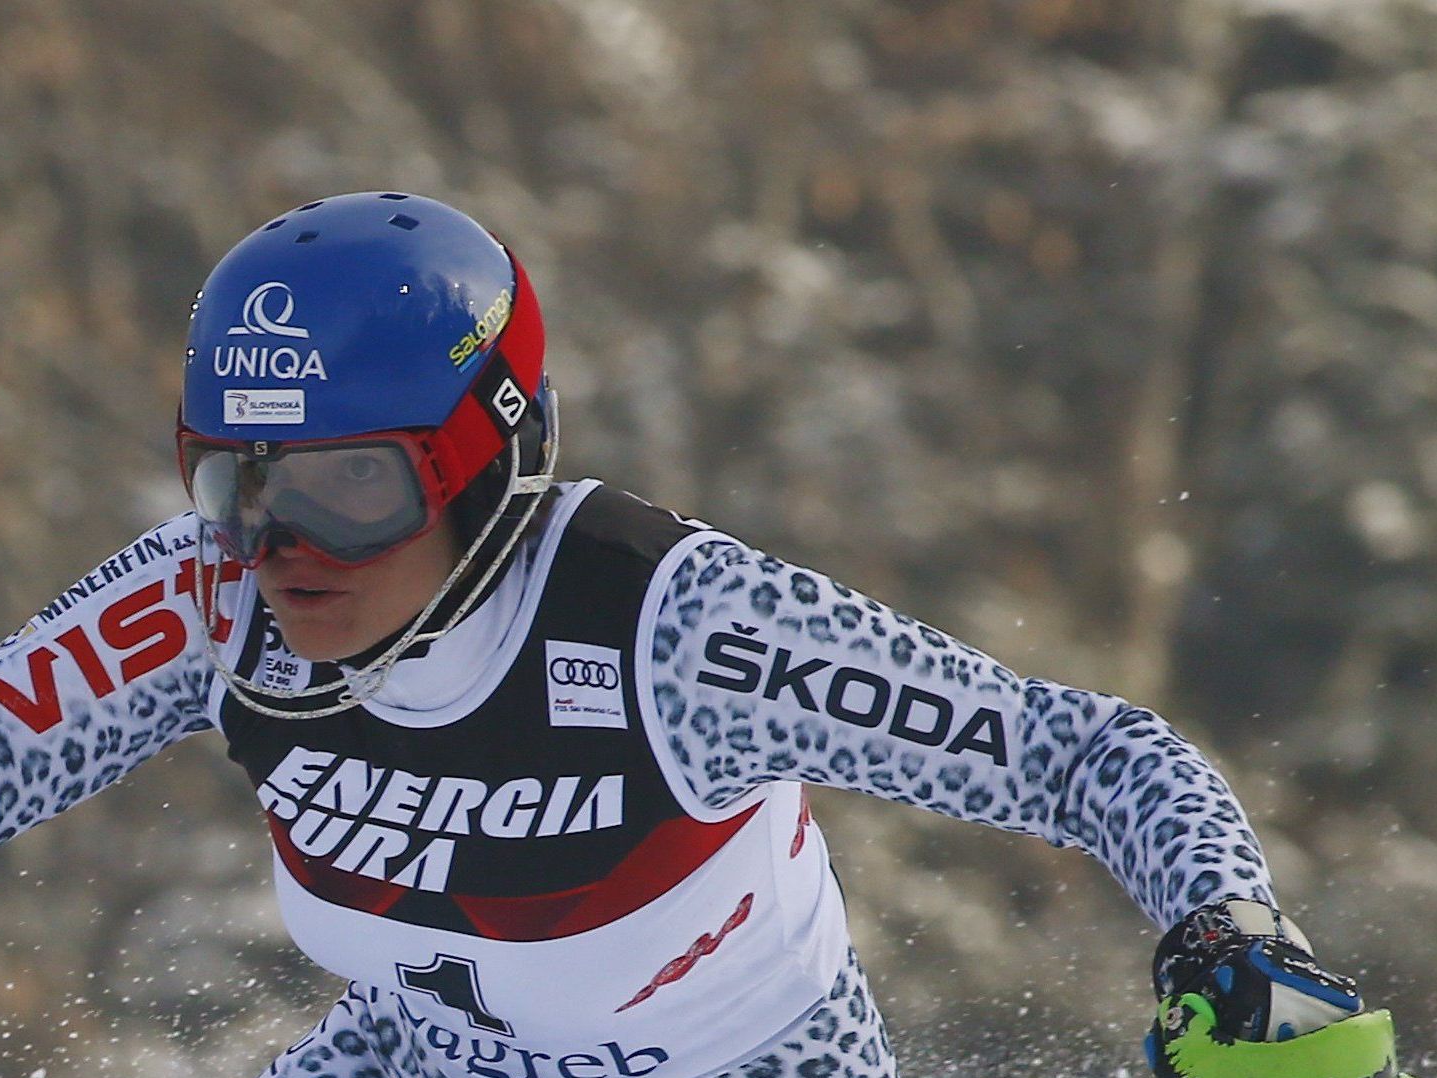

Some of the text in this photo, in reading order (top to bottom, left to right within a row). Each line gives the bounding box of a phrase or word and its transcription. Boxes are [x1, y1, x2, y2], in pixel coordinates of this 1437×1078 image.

[214, 346, 328, 381] UNIQA
[266, 657, 300, 677] EARS
[696, 621, 1008, 768] ŠKODA
[266, 745, 624, 839] ENERGIA
[395, 952, 516, 1038] 1
